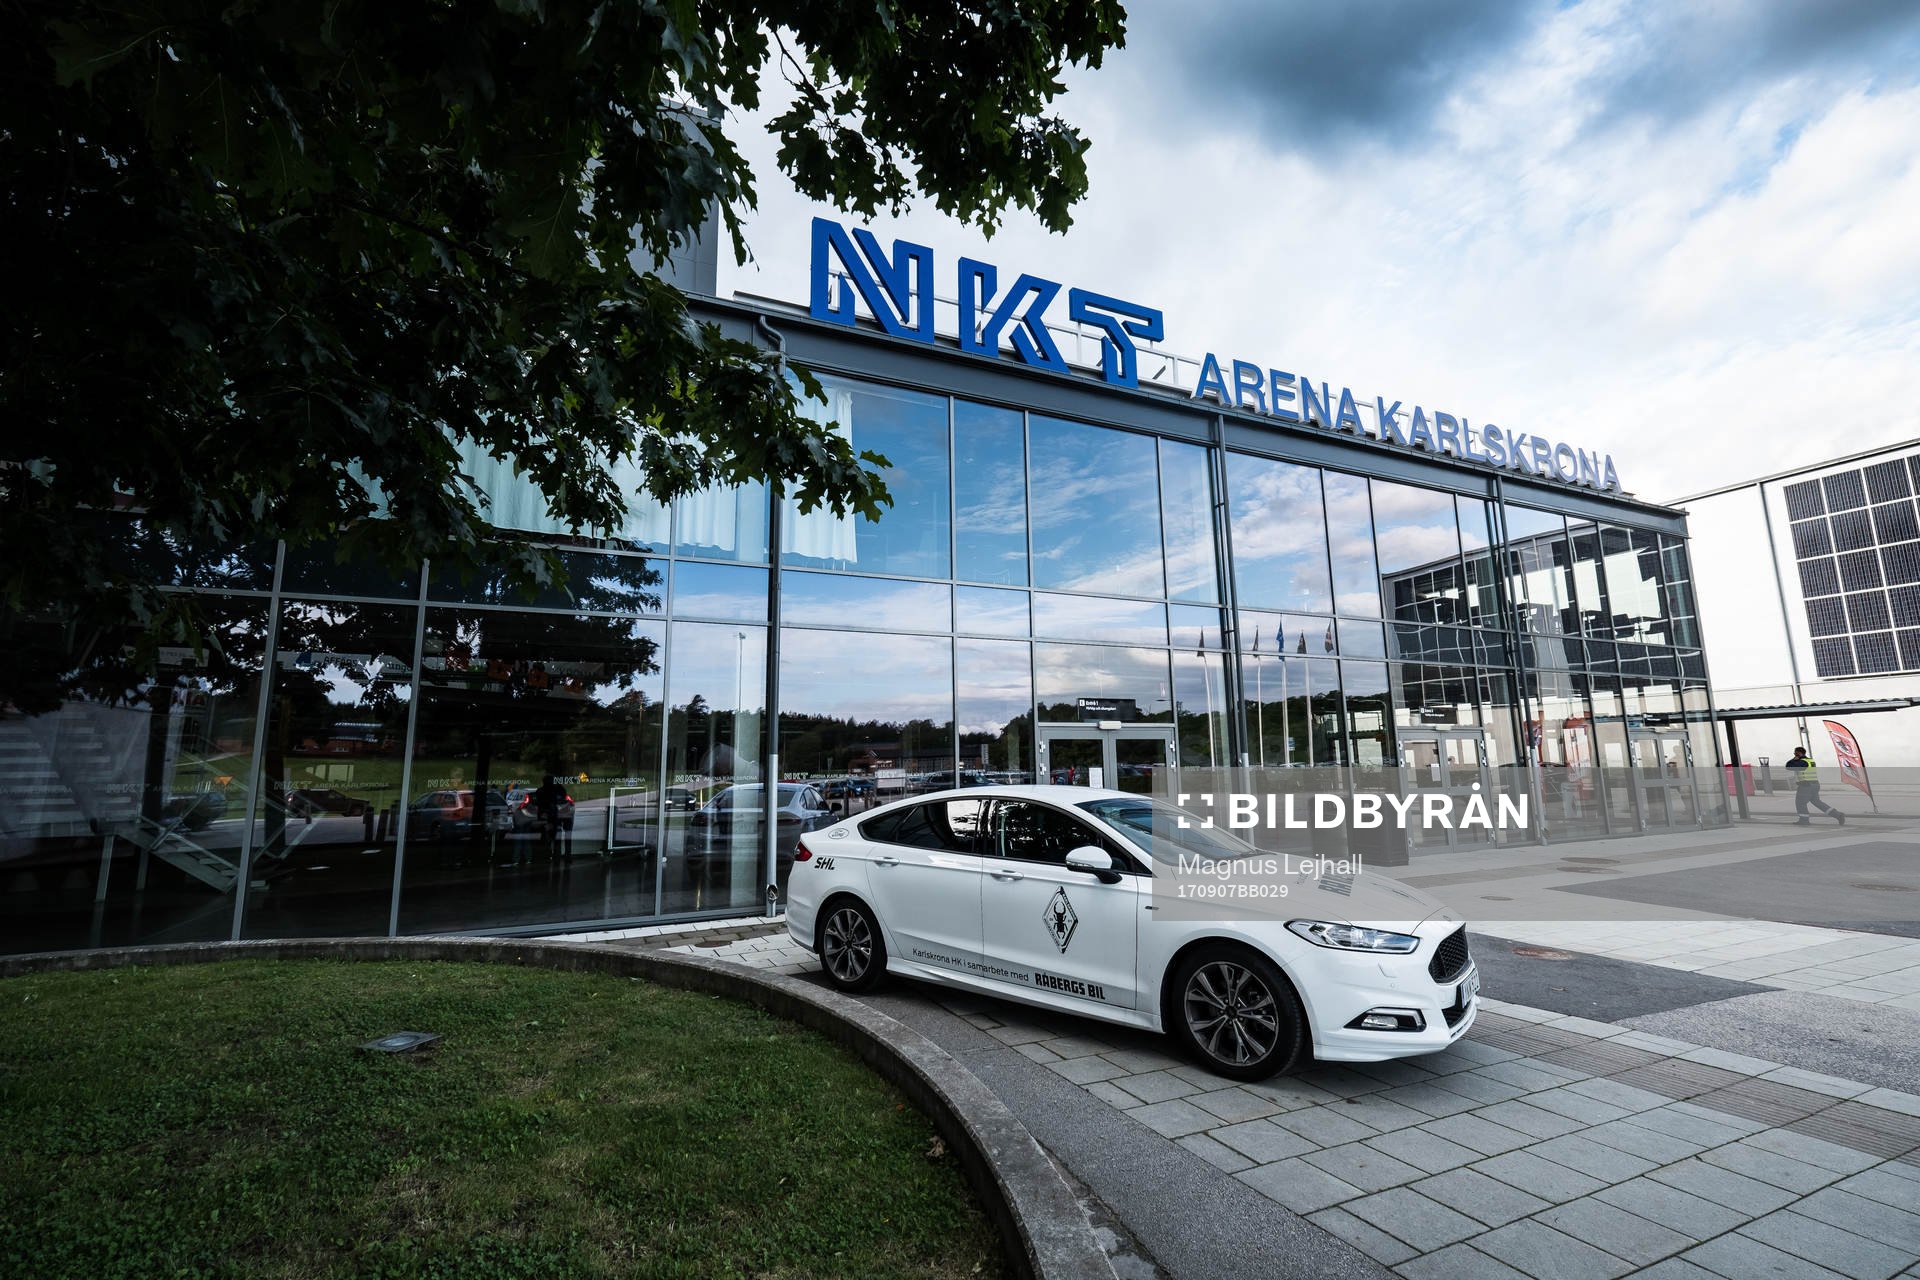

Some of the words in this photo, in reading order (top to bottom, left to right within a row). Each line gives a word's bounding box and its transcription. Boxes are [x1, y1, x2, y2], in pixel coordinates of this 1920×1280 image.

[810, 217, 1164, 388] NKT
[1192, 352, 1366, 435] ARENA
[1375, 396, 1624, 493] KARLSKRONA
[675, 774, 702, 783] NKT
[783, 772, 808, 780] NKT
[273, 781, 313, 790] NKT
[427, 778, 459, 788] NKT
[814, 857, 835, 870] SHL
[912, 948, 950, 963] Karlskrona
[951, 957, 963, 967] HK
[967, 961, 1009, 977] samarbete
[1010, 970, 1029, 981] med
[1035, 972, 1085, 995] RÅBERGS
[1087, 983, 1105, 1000] BIL
